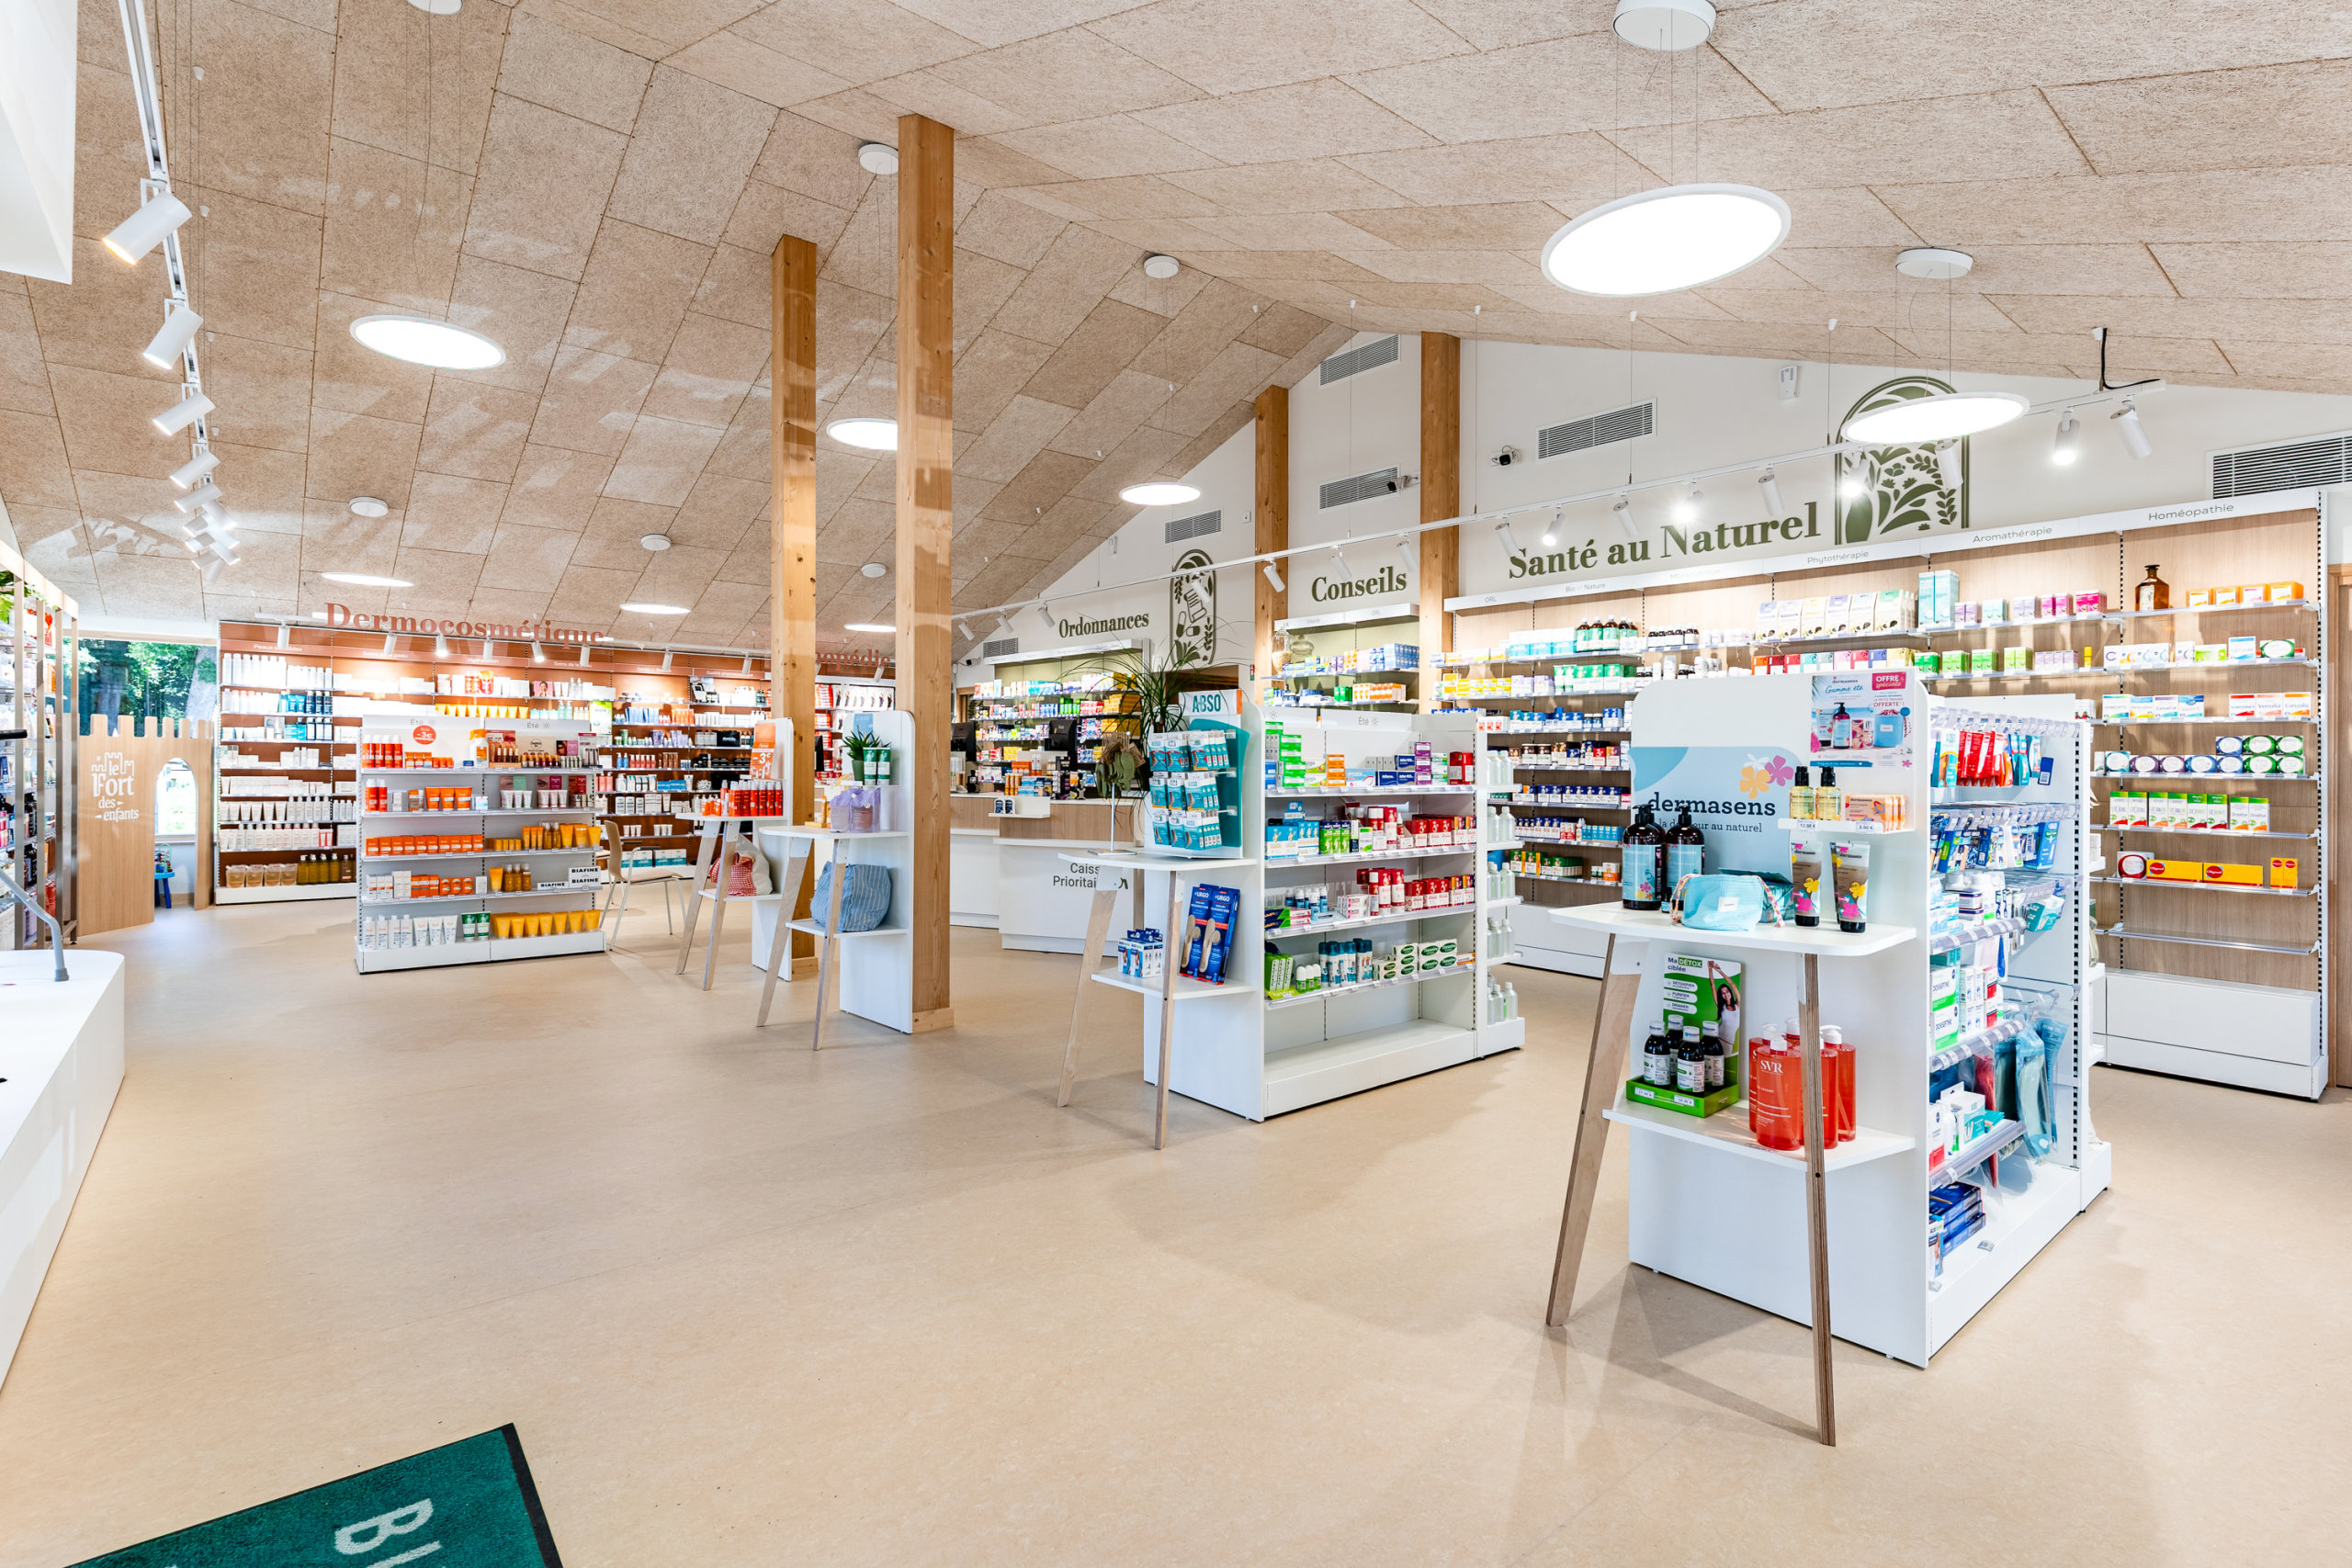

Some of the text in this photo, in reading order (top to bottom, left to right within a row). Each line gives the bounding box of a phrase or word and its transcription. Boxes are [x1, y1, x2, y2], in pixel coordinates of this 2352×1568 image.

[2148, 502, 2234, 521] Homéopathie
[1508, 500, 1822, 580] Santé au Naturel
[1972, 525, 2052, 544] Aromathérapie
[1806, 549, 1870, 566] Phytothérapie
[1310, 565, 1408, 603] Conseils
[1566, 585, 1576, 593] Bio
[1584, 581, 1606, 591] Nature
[323, 603, 604, 650] Dermocosmétique
[1058, 612, 1149, 639] Ordonnances
[254, 643, 274, 651] Peaux
[1825, 684, 1851, 694] Gamme
[1192, 694, 1221, 713] ABSO
[1358, 716, 1370, 726] Été
[108, 761, 119, 775] le
[91, 773, 135, 797] Fort
[98, 795, 116, 809] des
[1647, 791, 1776, 817] dermasens
[103, 807, 140, 823] enfants
[1659, 818, 1668, 828] la
[1669, 818, 1709, 830] deur
[1725, 822, 1763, 833] naturel
[1069, 863, 1100, 874] Caiss
[1053, 875, 1097, 888] Prioritai
[1216, 894, 1230, 902] URGO
[1679, 958, 1702, 967] DÉTOX
[1760, 1059, 1784, 1074] SVR
